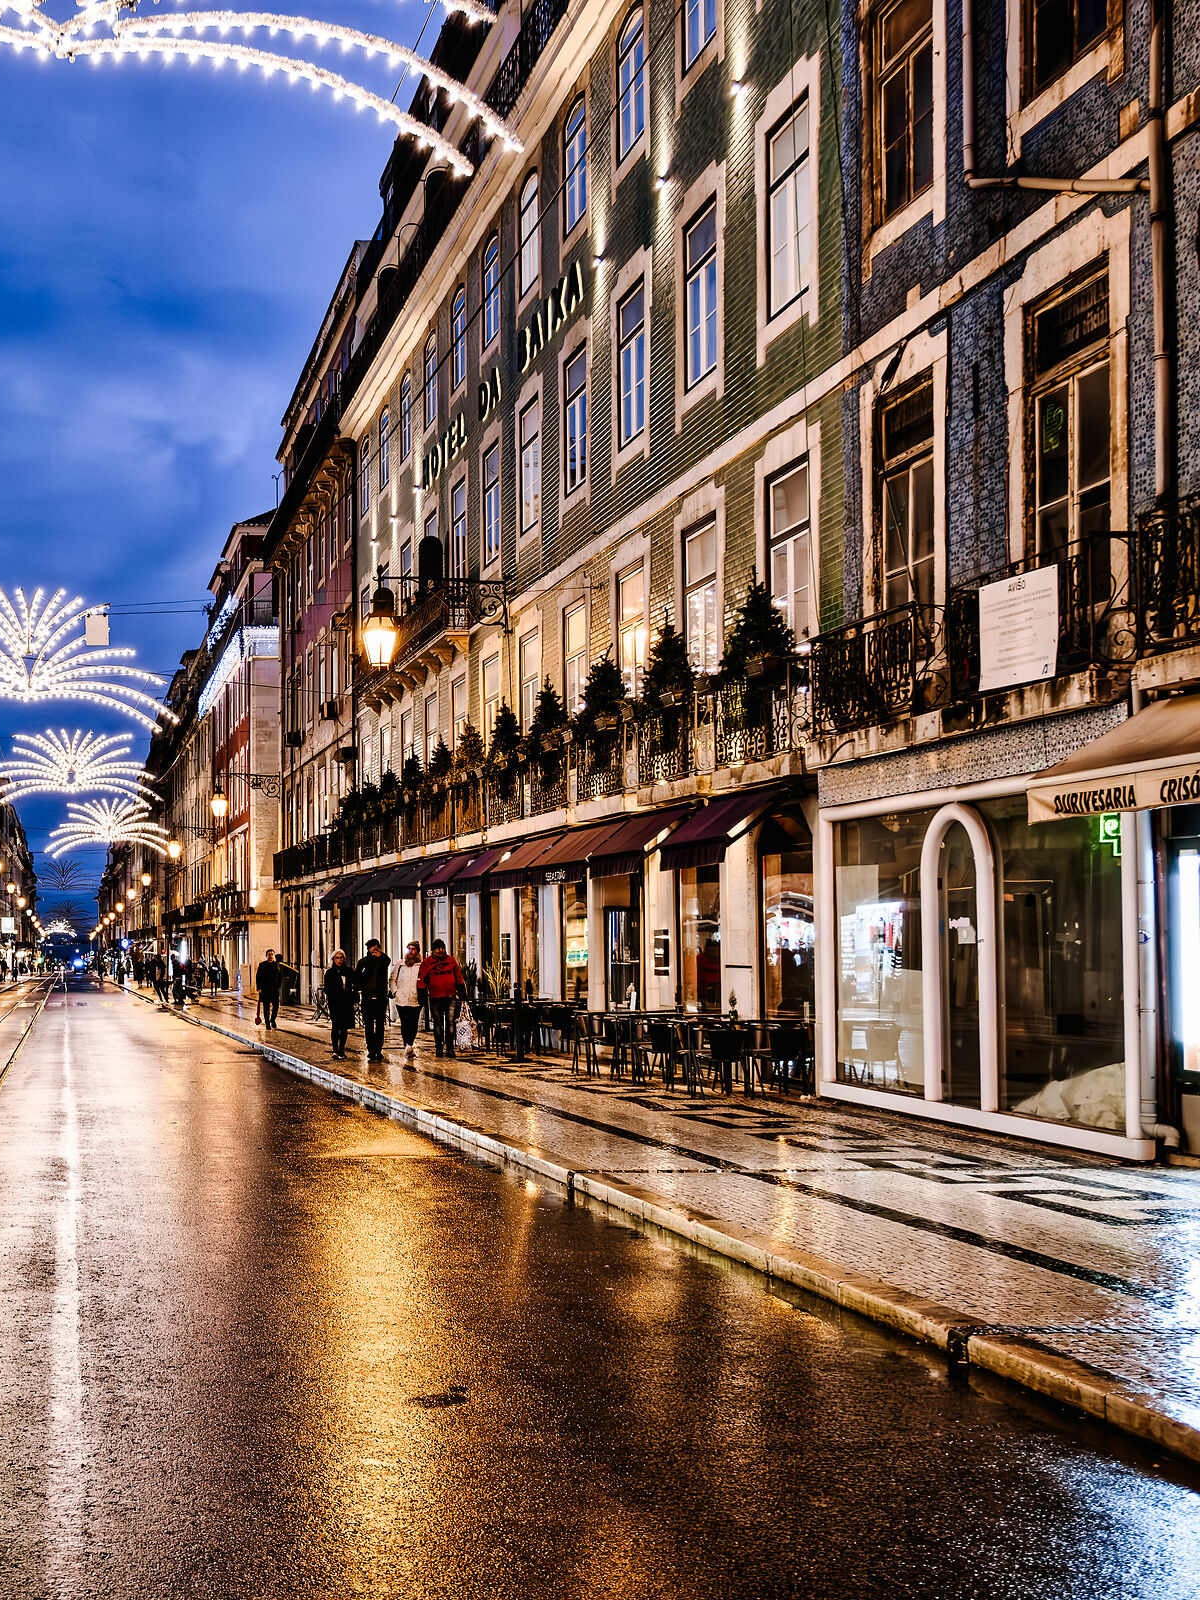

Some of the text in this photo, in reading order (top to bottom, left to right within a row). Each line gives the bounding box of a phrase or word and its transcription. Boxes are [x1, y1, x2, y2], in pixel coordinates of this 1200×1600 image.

[422, 259, 584, 491] HOTEL DA BAIXA
[1007, 578, 1027, 593] AVISO
[1053, 770, 1200, 815] OURIVESARIA CRISÓ
